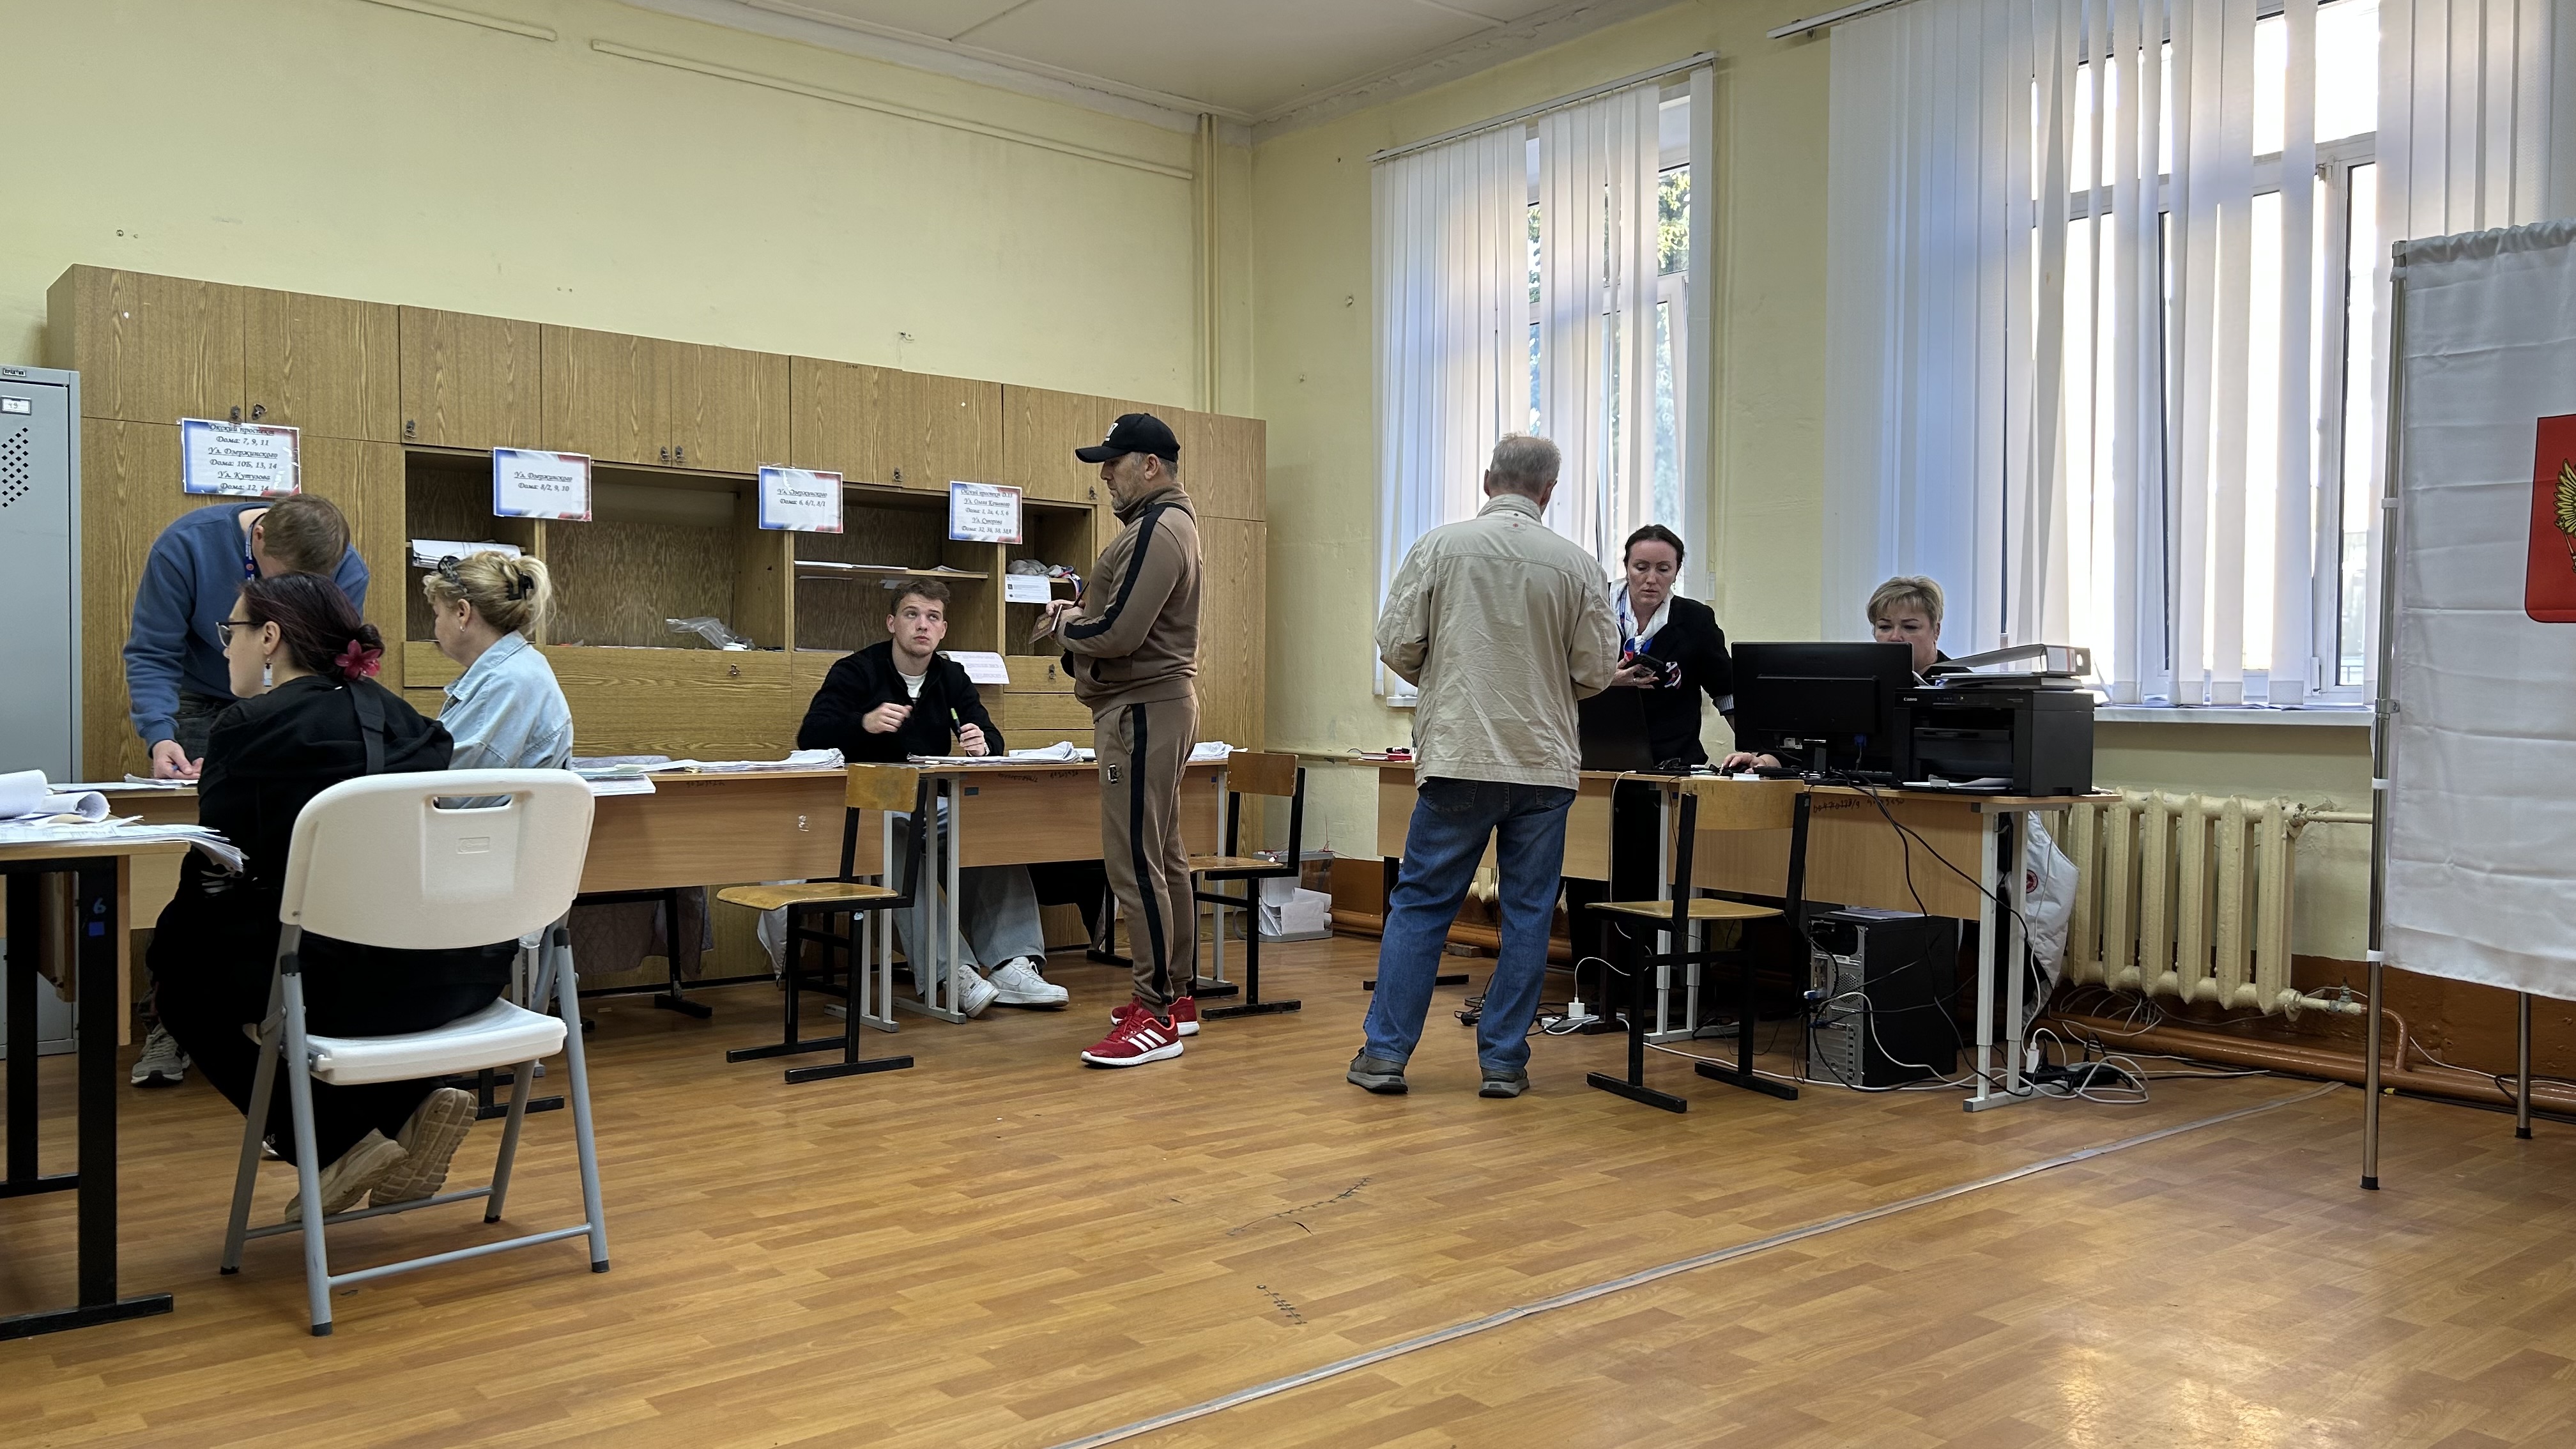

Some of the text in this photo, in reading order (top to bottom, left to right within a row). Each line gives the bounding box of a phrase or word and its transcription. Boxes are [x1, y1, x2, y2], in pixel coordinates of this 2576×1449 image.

[216, 436, 240, 444] Дома:
[224, 448, 279, 459] Дзержинского
[234, 471, 271, 482] Кутузова
[93, 897, 107, 914] 6
